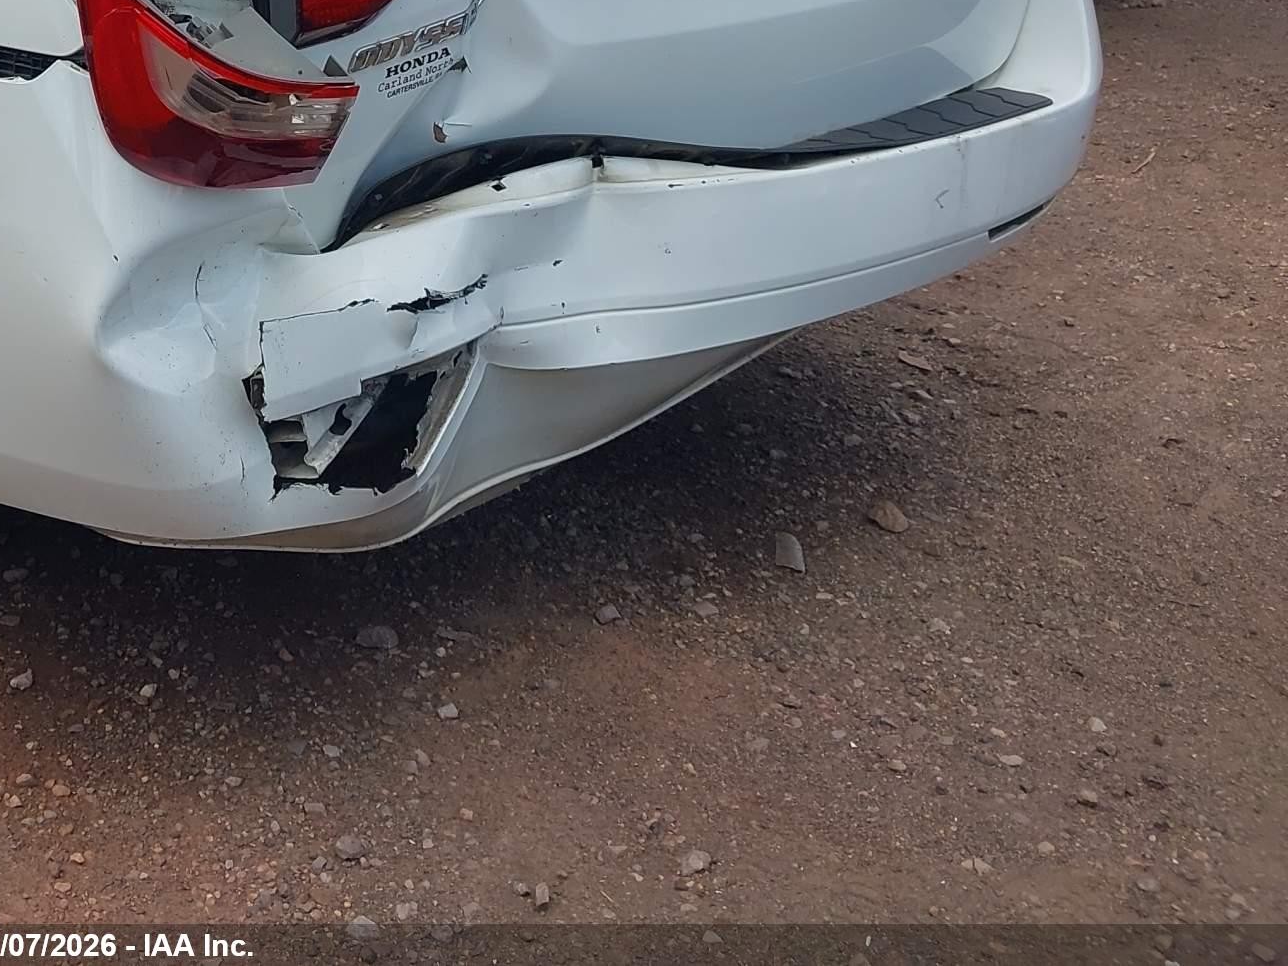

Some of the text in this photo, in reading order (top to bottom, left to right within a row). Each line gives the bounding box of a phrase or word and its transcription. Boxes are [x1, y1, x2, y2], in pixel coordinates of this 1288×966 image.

[378, 57, 454, 93] Carland North
[385, 46, 451, 79] HONDA
[387, 77, 434, 99] CARTERSVILLE
